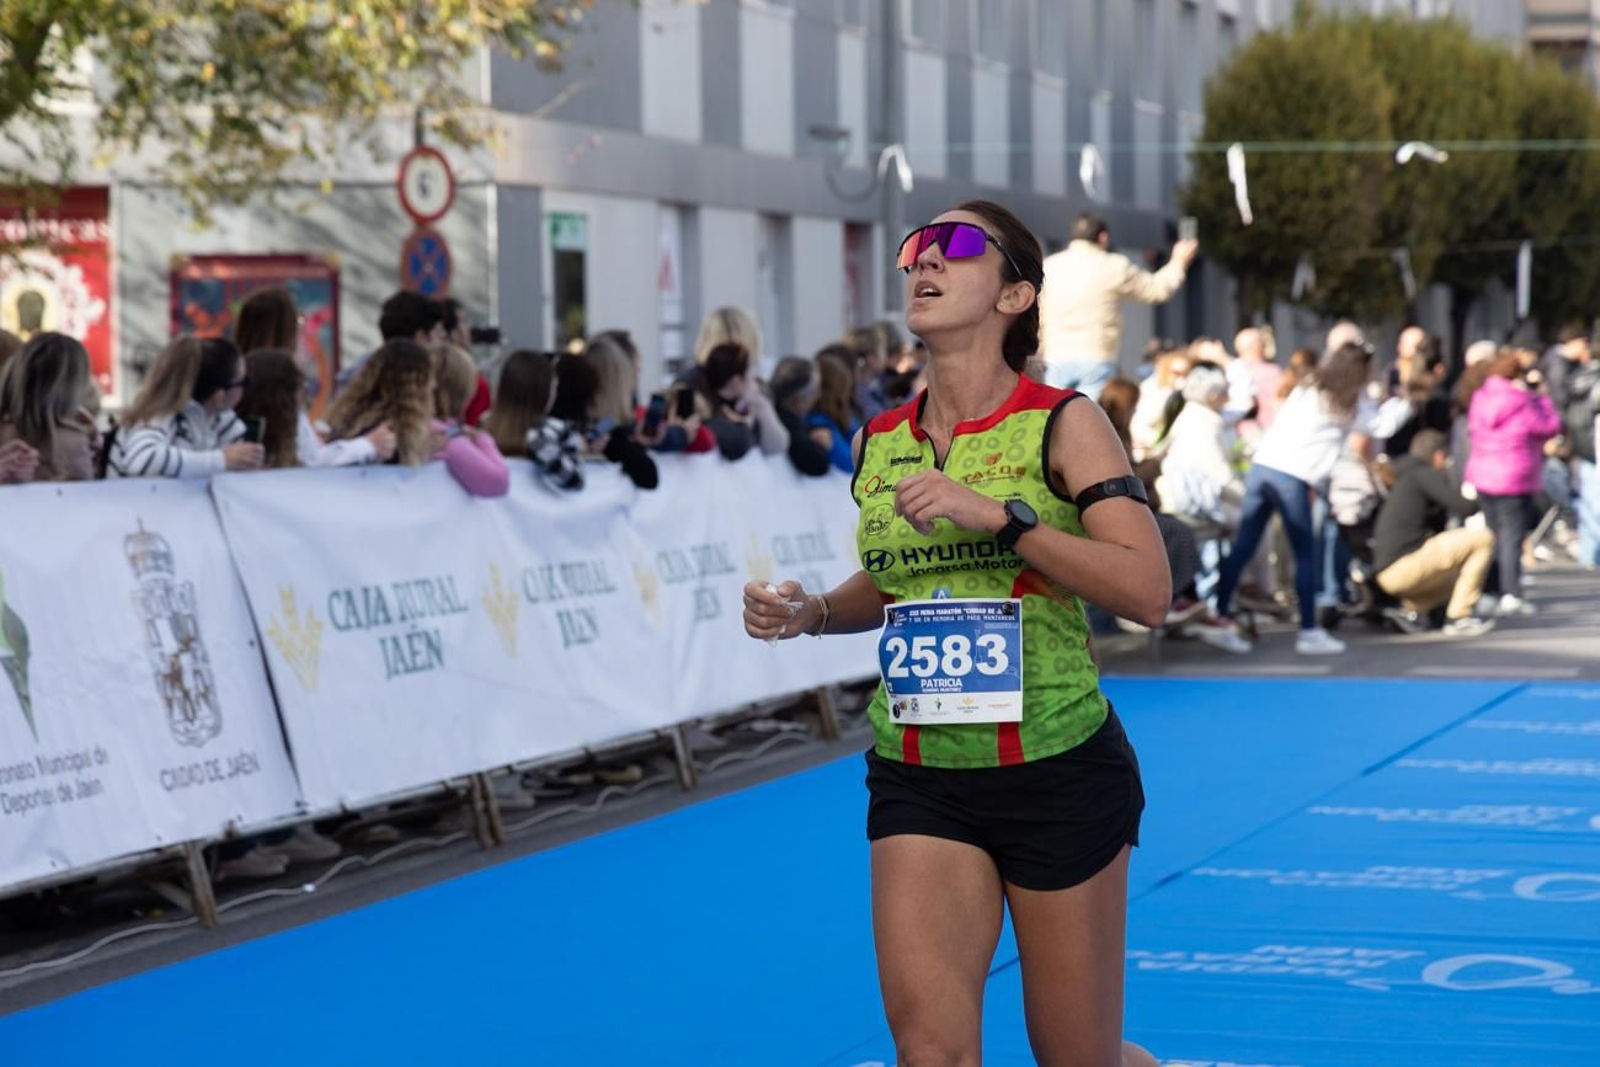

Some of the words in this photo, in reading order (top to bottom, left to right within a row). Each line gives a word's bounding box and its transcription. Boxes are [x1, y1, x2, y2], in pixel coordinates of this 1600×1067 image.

[901, 541, 1016, 566] HYUNDA
[327, 586, 392, 632] CAJA
[391, 575, 469, 622] RURAL
[378, 623, 444, 681] JAÉN
[886, 634, 1008, 678] 2583
[921, 678, 963, 688] PATRICIA
